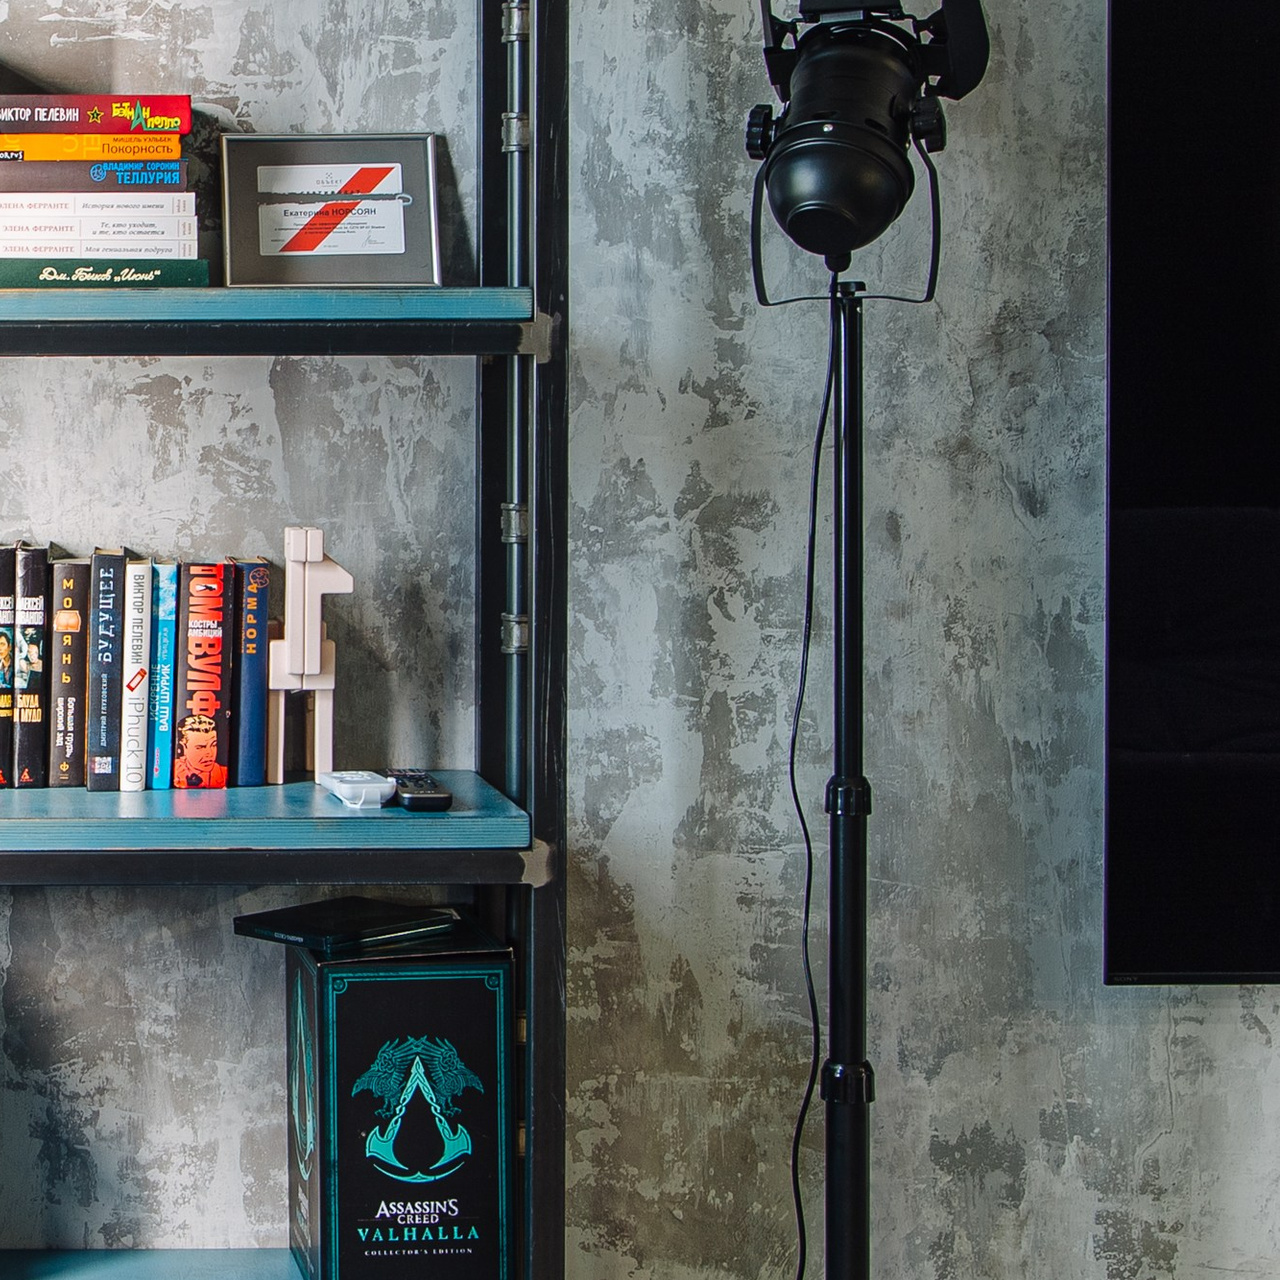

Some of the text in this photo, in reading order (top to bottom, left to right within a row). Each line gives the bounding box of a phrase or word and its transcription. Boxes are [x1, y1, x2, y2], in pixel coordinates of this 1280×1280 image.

[34, 107, 79, 122] ПЕЛЕВИН
[102, 143, 173, 156] Покорность
[102, 162, 180, 171] ВЛАДИМИР СОРОКИН
[116, 172, 180, 184] ТЕЛЛУРИЯ
[283, 207, 377, 218] Екатерина НОРСОЯН
[98, 568, 116, 663] БУДУЩЕЕ
[131, 574, 145, 664] ВИКТОР ПЕЛЕВИН
[188, 620, 218, 628] КОСТРЫ
[246, 583, 258, 654] НОРМА
[186, 563, 224, 718] ТОМ ВУЛФ
[188, 627, 223, 638] АМБИЦИЙ
[149, 663, 160, 721] ИСКРЕННЕ
[158, 664, 171, 731] ВАШ ШУРИК
[100, 716, 108, 747] ДМИТРИЙ
[126, 697, 144, 784] iPhuck 10
[375, 1199, 459, 1218] ASSASSIN'S
[397, 1214, 439, 1224] CREED
[357, 1226, 479, 1241] VALHALLA
